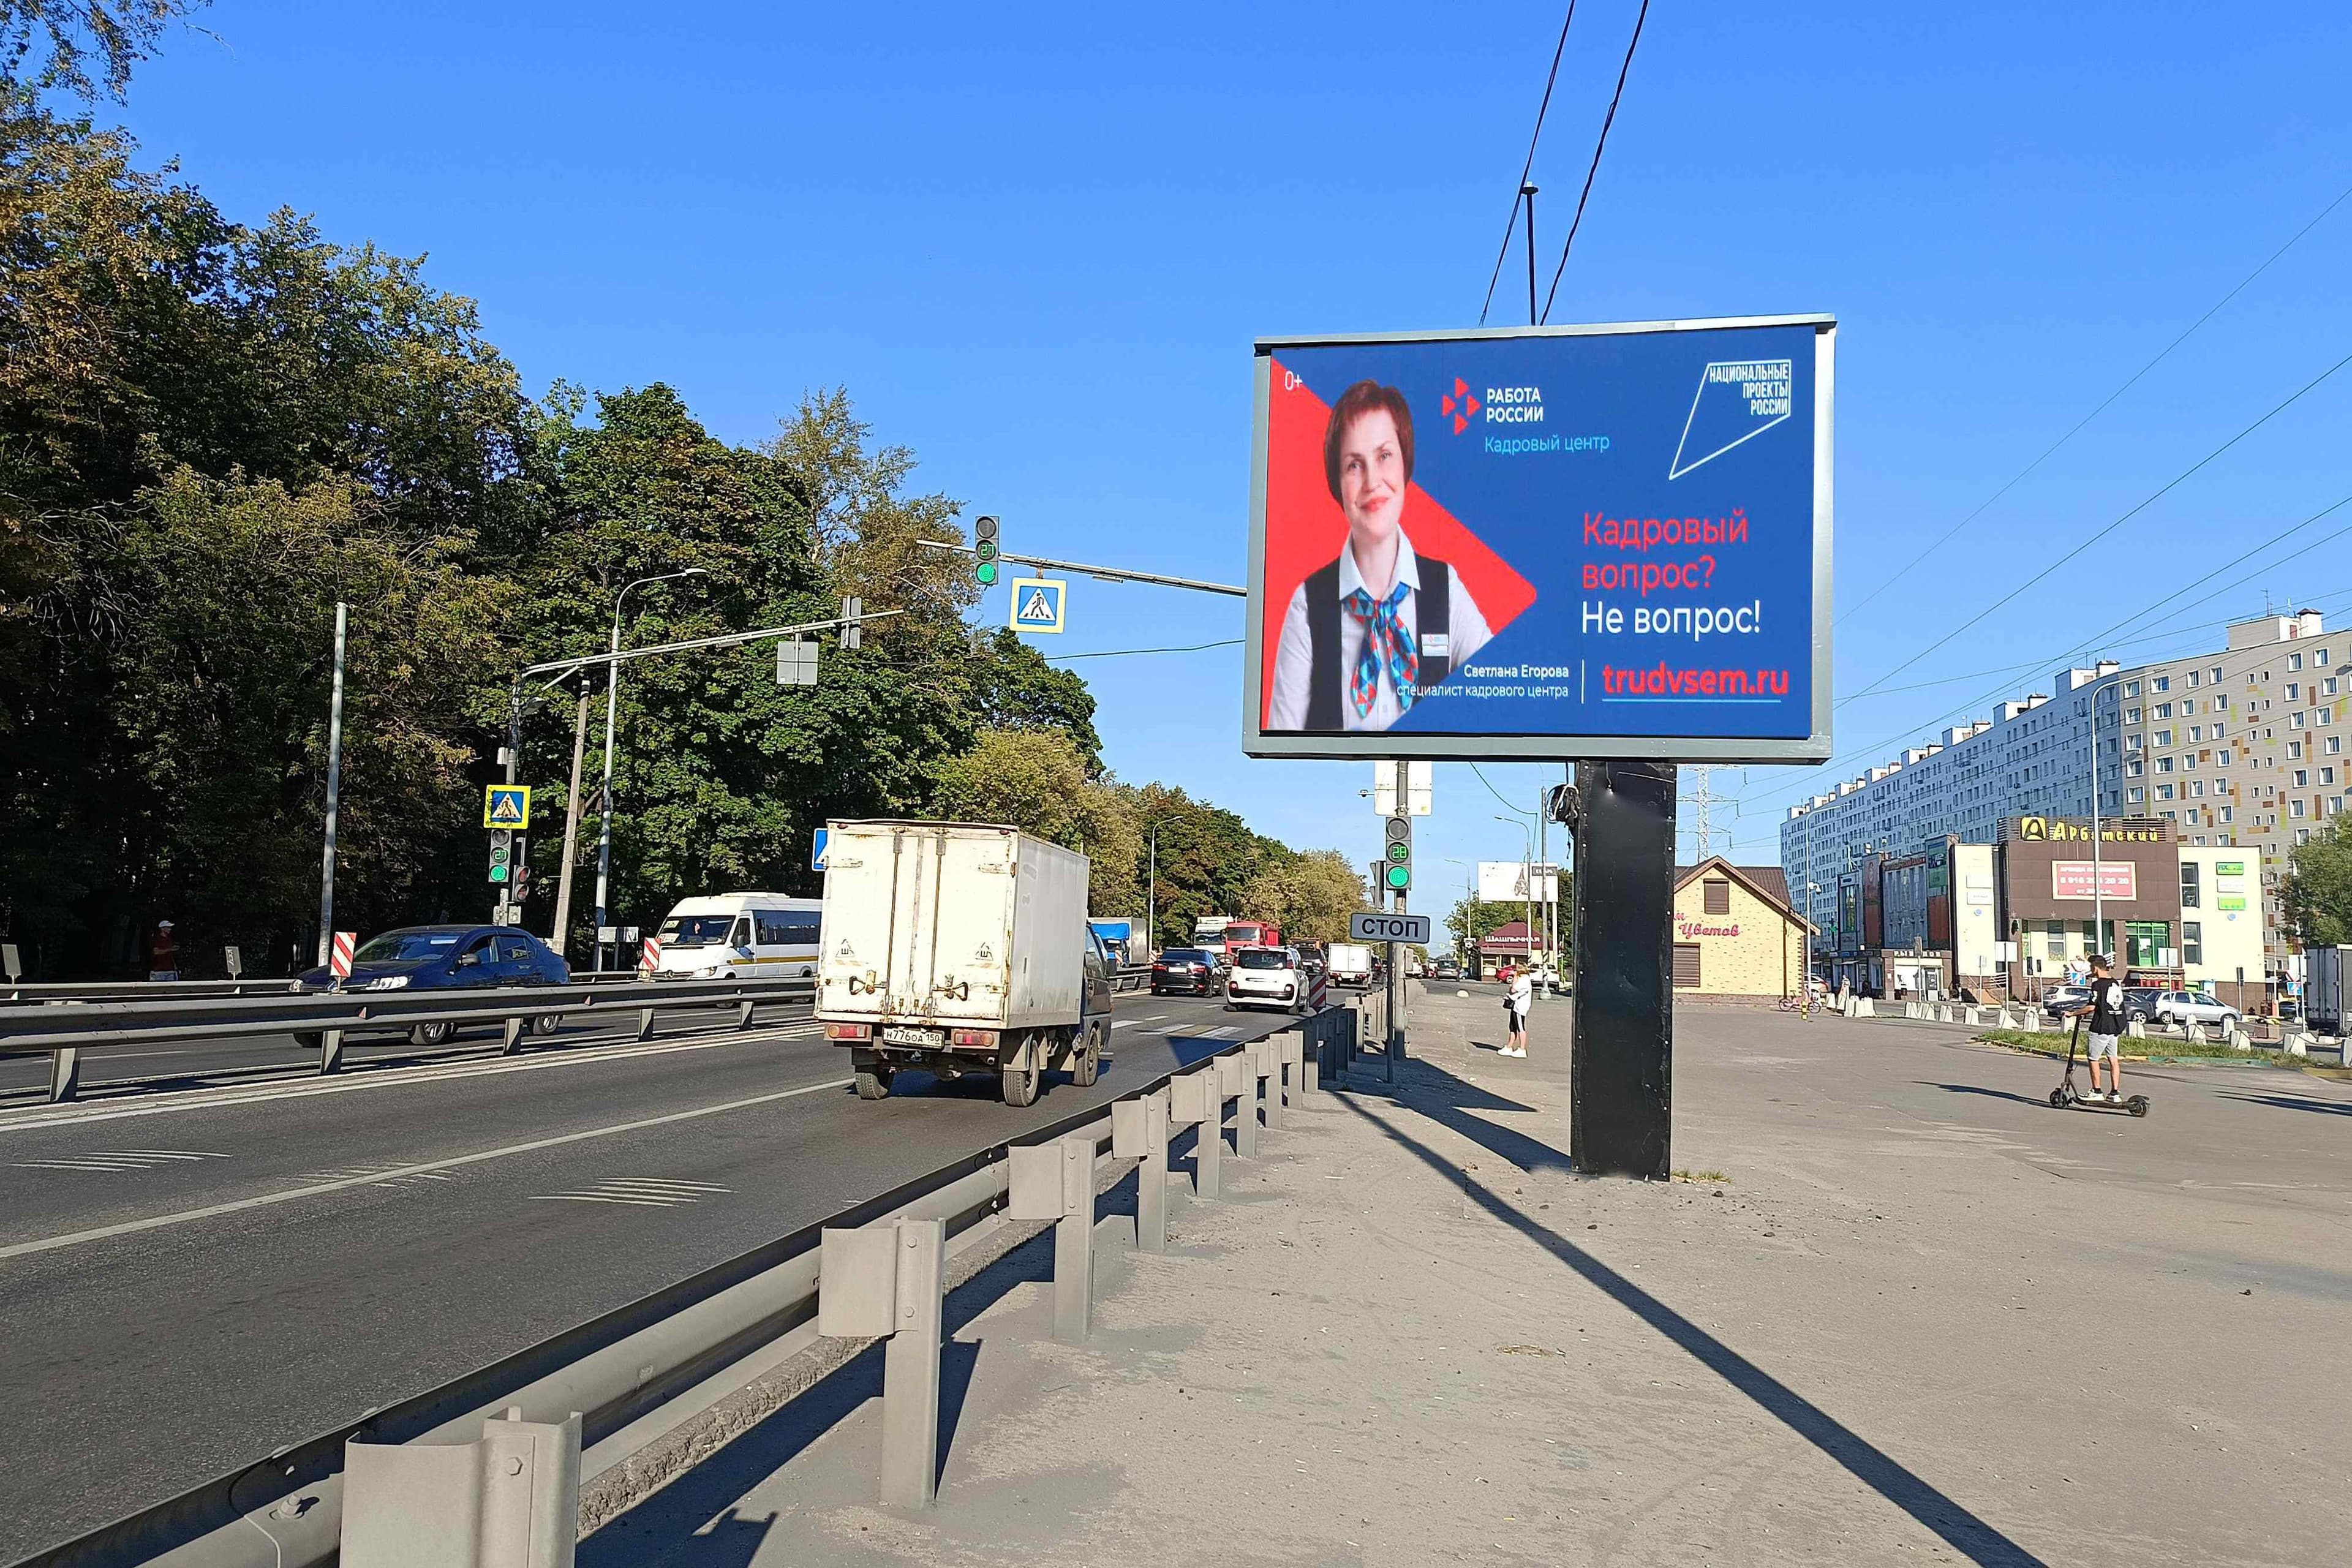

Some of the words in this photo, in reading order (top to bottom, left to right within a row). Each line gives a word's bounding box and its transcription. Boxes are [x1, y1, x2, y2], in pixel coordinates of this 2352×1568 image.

[1284, 371, 1303, 390] 0+
[1709, 364, 1789, 383] НАЦИОНАЛЬНЫЕ
[1486, 387, 1542, 403] РАБОТА
[1743, 381, 1788, 399] ПРОЕКТЫ
[1486, 407, 1544, 423] РОССИИ
[1751, 399, 1787, 415] РОССИИ
[1485, 434, 1559, 454] Кадровый
[1564, 435, 1610, 453] центр
[1583, 509, 1748, 551] Кадровый
[981, 545, 994, 556] 27
[1582, 555, 1716, 598] вопрос?
[1582, 601, 1623, 633] Не
[1634, 600, 1760, 642] вопрос!
[1464, 664, 1517, 677] Светлана
[1521, 665, 1569, 679] Егорова
[1602, 661, 1789, 694] trudvsem.ru
[1396, 685, 1463, 697] специалист
[1465, 685, 1525, 698] кадрового
[1528, 686, 1568, 699] центра
[1392, 846, 1407, 858] 28
[1362, 919, 1419, 938] СТОП
[1679, 923, 1740, 939] Цветов
